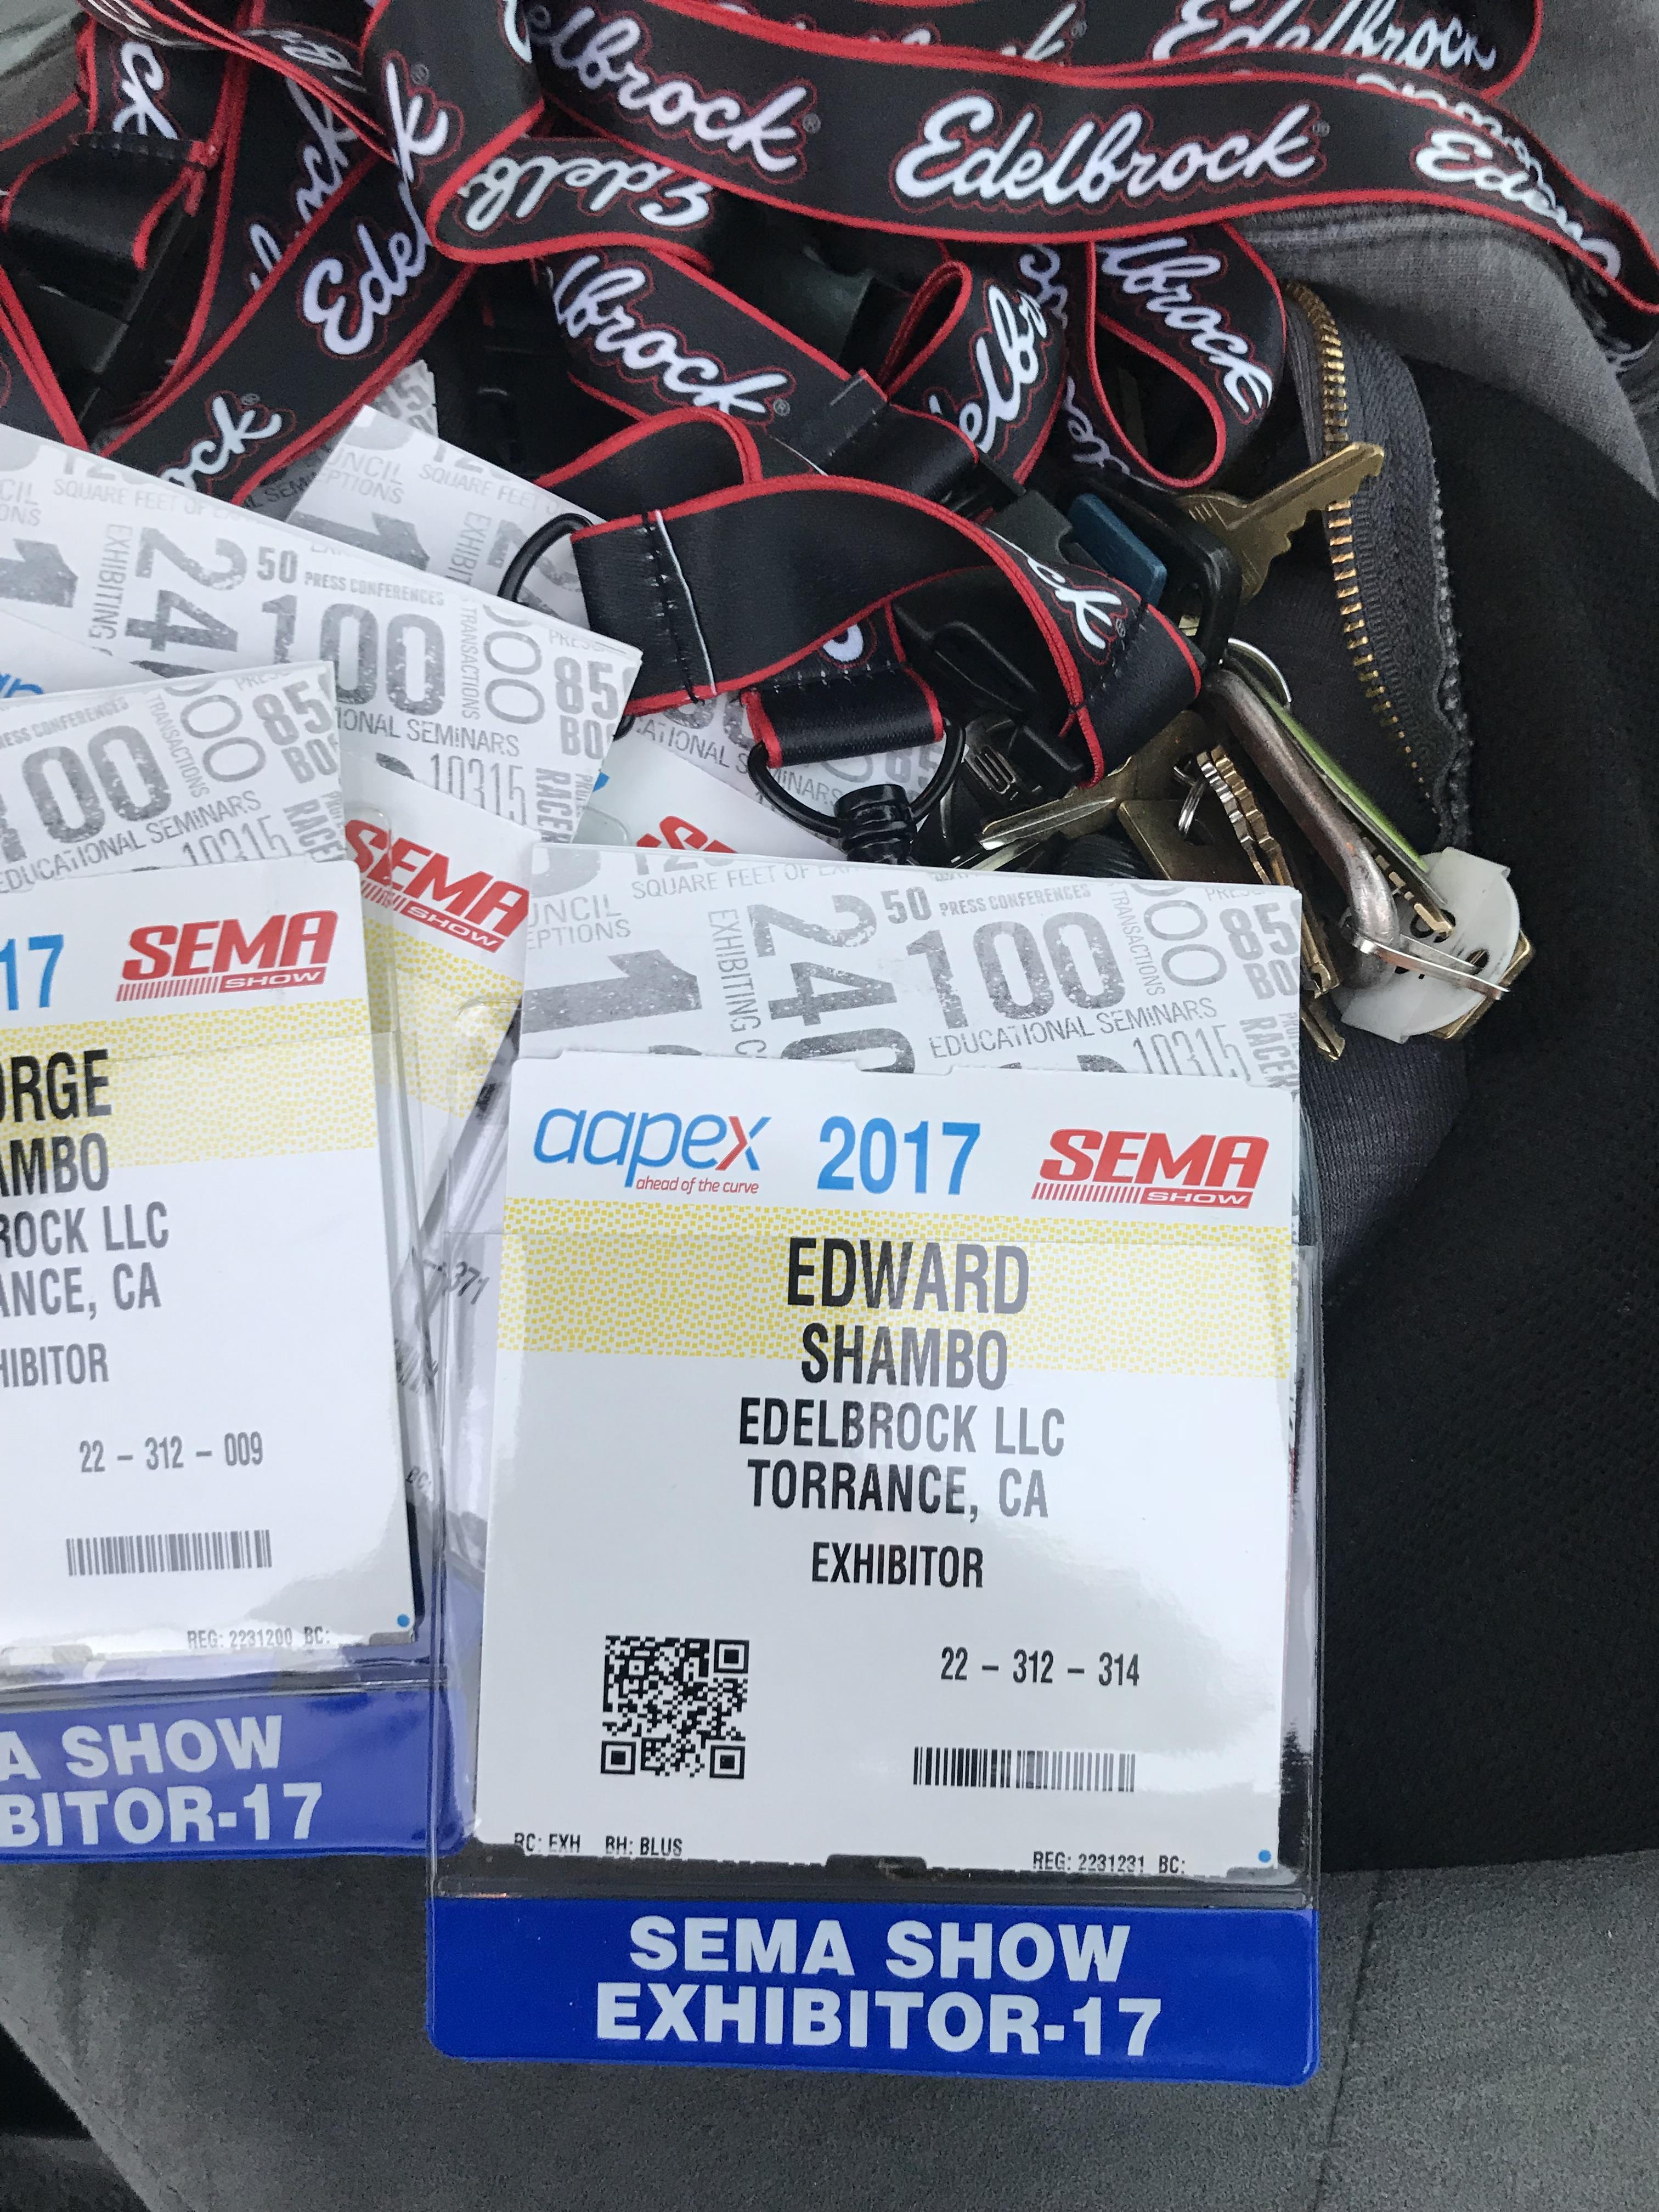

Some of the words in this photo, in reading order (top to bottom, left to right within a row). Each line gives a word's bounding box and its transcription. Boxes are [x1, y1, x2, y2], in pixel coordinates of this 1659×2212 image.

[257, 548, 298, 583] 50
[304, 571, 347, 592] PRESS
[345, 819, 531, 938] SEMA
[631, 870, 718, 900] SQUARE
[727, 865, 778, 889] FEET
[939, 900, 987, 917] PRESS
[989, 884, 1091, 911] CONFERENCES
[406, 905, 500, 949] SHOW
[881, 886, 932, 924] 50
[123, 910, 338, 981] SEMA
[225, 970, 320, 989] SHOW
[708, 909, 763, 1033] EXHIBITING
[906, 911, 1126, 1030] 100
[929, 1017, 1095, 1059] EDUCATIONAL
[533, 1107, 772, 1188] aapex
[817, 1115, 981, 1195] 2017
[1039, 1128, 1269, 1189] SEMA
[636, 1176, 678, 1192] ahead
[680, 1177, 697, 1195] of
[698, 1179, 720, 1193] the
[723, 1181, 759, 1195] curve
[1146, 1190, 1248, 1205] SHOW
[103, 1201, 169, 1251] LLC
[112, 1261, 161, 1310] CA
[788, 1237, 1029, 1314] EDWARD
[801, 1323, 1008, 1390] SHAMBO
[740, 1397, 978, 1453] EDELBROCK
[995, 1406, 1065, 1457] LLC
[80, 1440, 105, 1473] 22
[145, 1435, 184, 1470] 312
[224, 1431, 263, 1466] 009
[747, 1459, 979, 1523] TORRANCE,
[998, 1468, 1048, 1518] CA
[812, 1542, 984, 1588] EXHIBITOR
[941, 1646, 968, 1680] 22
[1013, 1649, 1054, 1684] 312
[1098, 1652, 1139, 1686] 314
[61, 1715, 283, 1779] SHOW
[640, 1837, 683, 1857] BLUS
[1032, 1851, 1072, 1871] REG:
[1078, 1854, 1145, 1873] 2231231
[1158, 1855, 1186, 1874] BC:
[629, 1916, 856, 1976] SEMA
[885, 1920, 1131, 1983] SHOW
[597, 1981, 1163, 2065] EXHIBITOR-17
